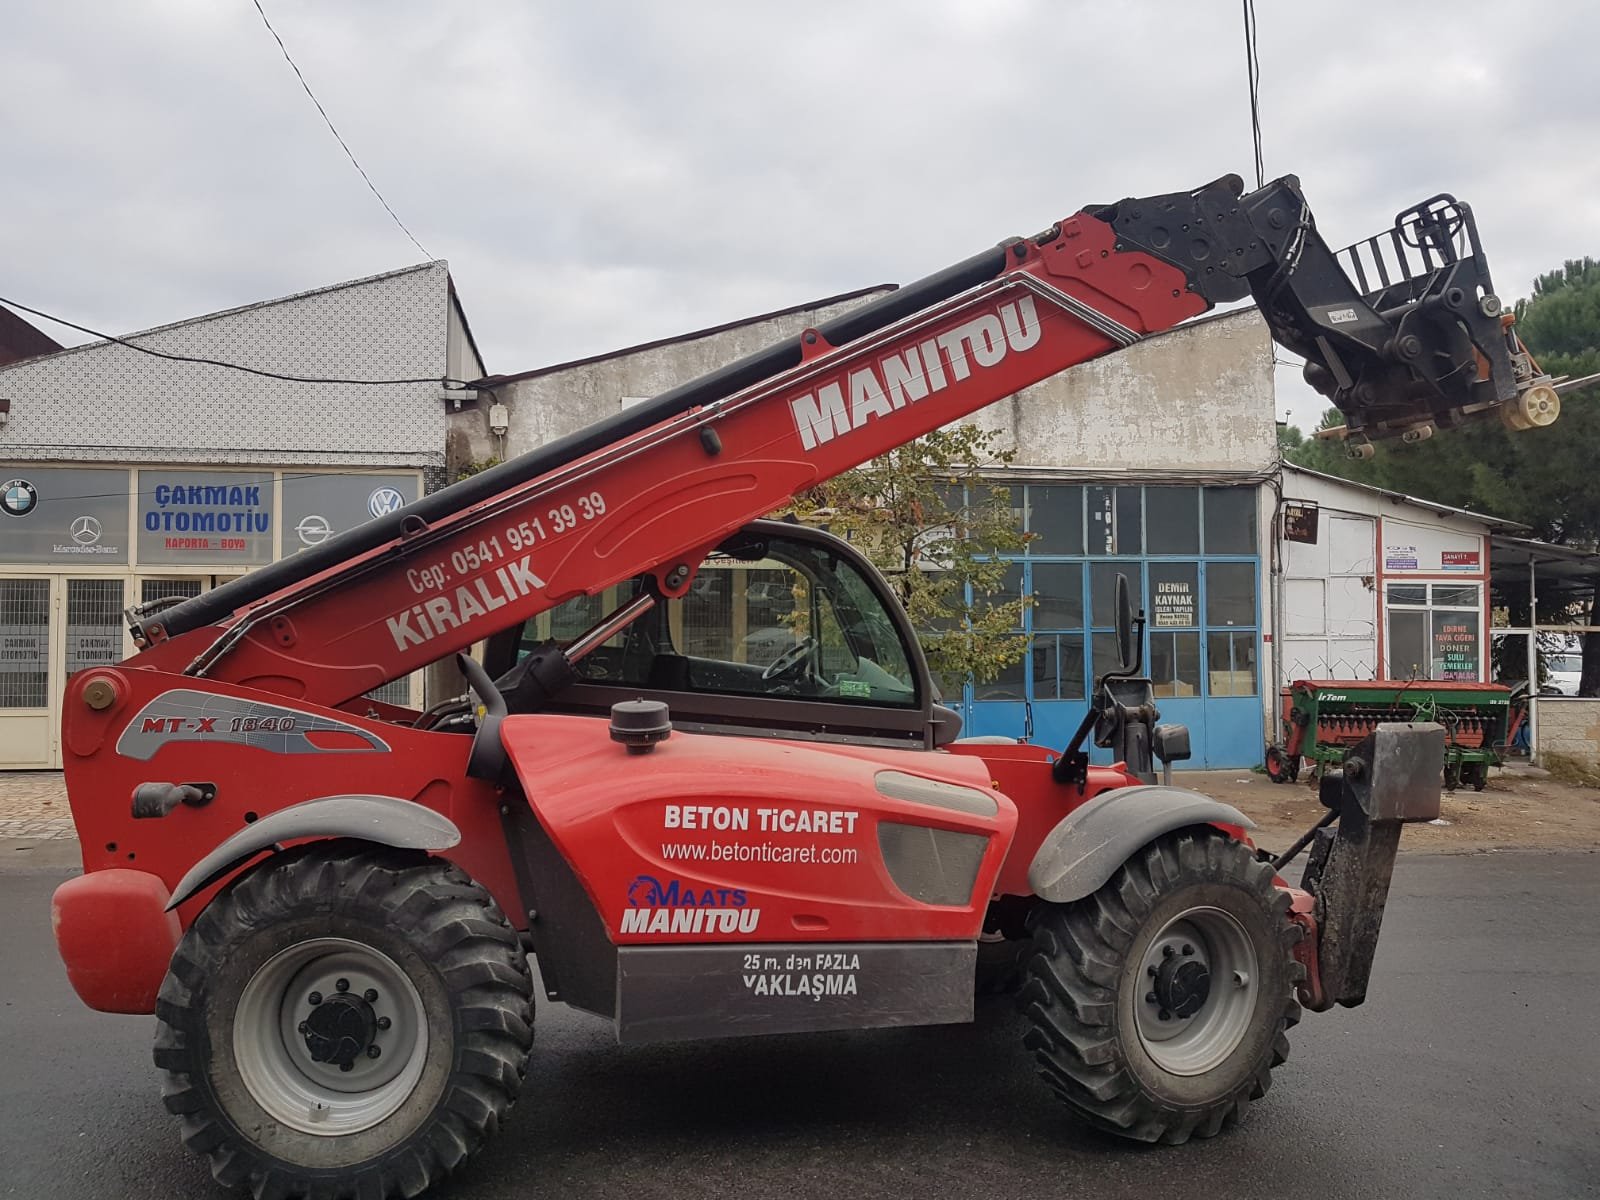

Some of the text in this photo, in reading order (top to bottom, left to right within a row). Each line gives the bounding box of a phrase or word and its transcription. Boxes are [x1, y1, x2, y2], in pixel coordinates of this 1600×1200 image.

[791, 294, 1042, 451] MANITOU
[155, 484, 260, 509] ÇAKMAK
[145, 508, 269, 532] OTOMOTİV
[165, 538, 209, 548] KAPORTA
[221, 538, 246, 549] BOYA
[451, 535, 504, 576] 0541
[506, 517, 547, 552] 951
[548, 505, 576, 534] 39
[578, 491, 607, 520] 39
[53, 544, 118, 554] Mercedes-Benz
[1155, 595, 1193, 605] KAYNAK
[1435, 634, 1452, 642] TAVA
[1439, 662, 1473, 670] YEMEKLER
[141, 717, 297, 733] MT-X 1840
[664, 805, 749, 831] BETON
[661, 841, 858, 865] www.betonticaret.com
[619, 908, 761, 935] MANITOU
[743, 954, 760, 971] 25
[764, 957, 781, 970] m.
[815, 954, 860, 971] FAZLA
[743, 974, 858, 1002] YAKLAŞMA
